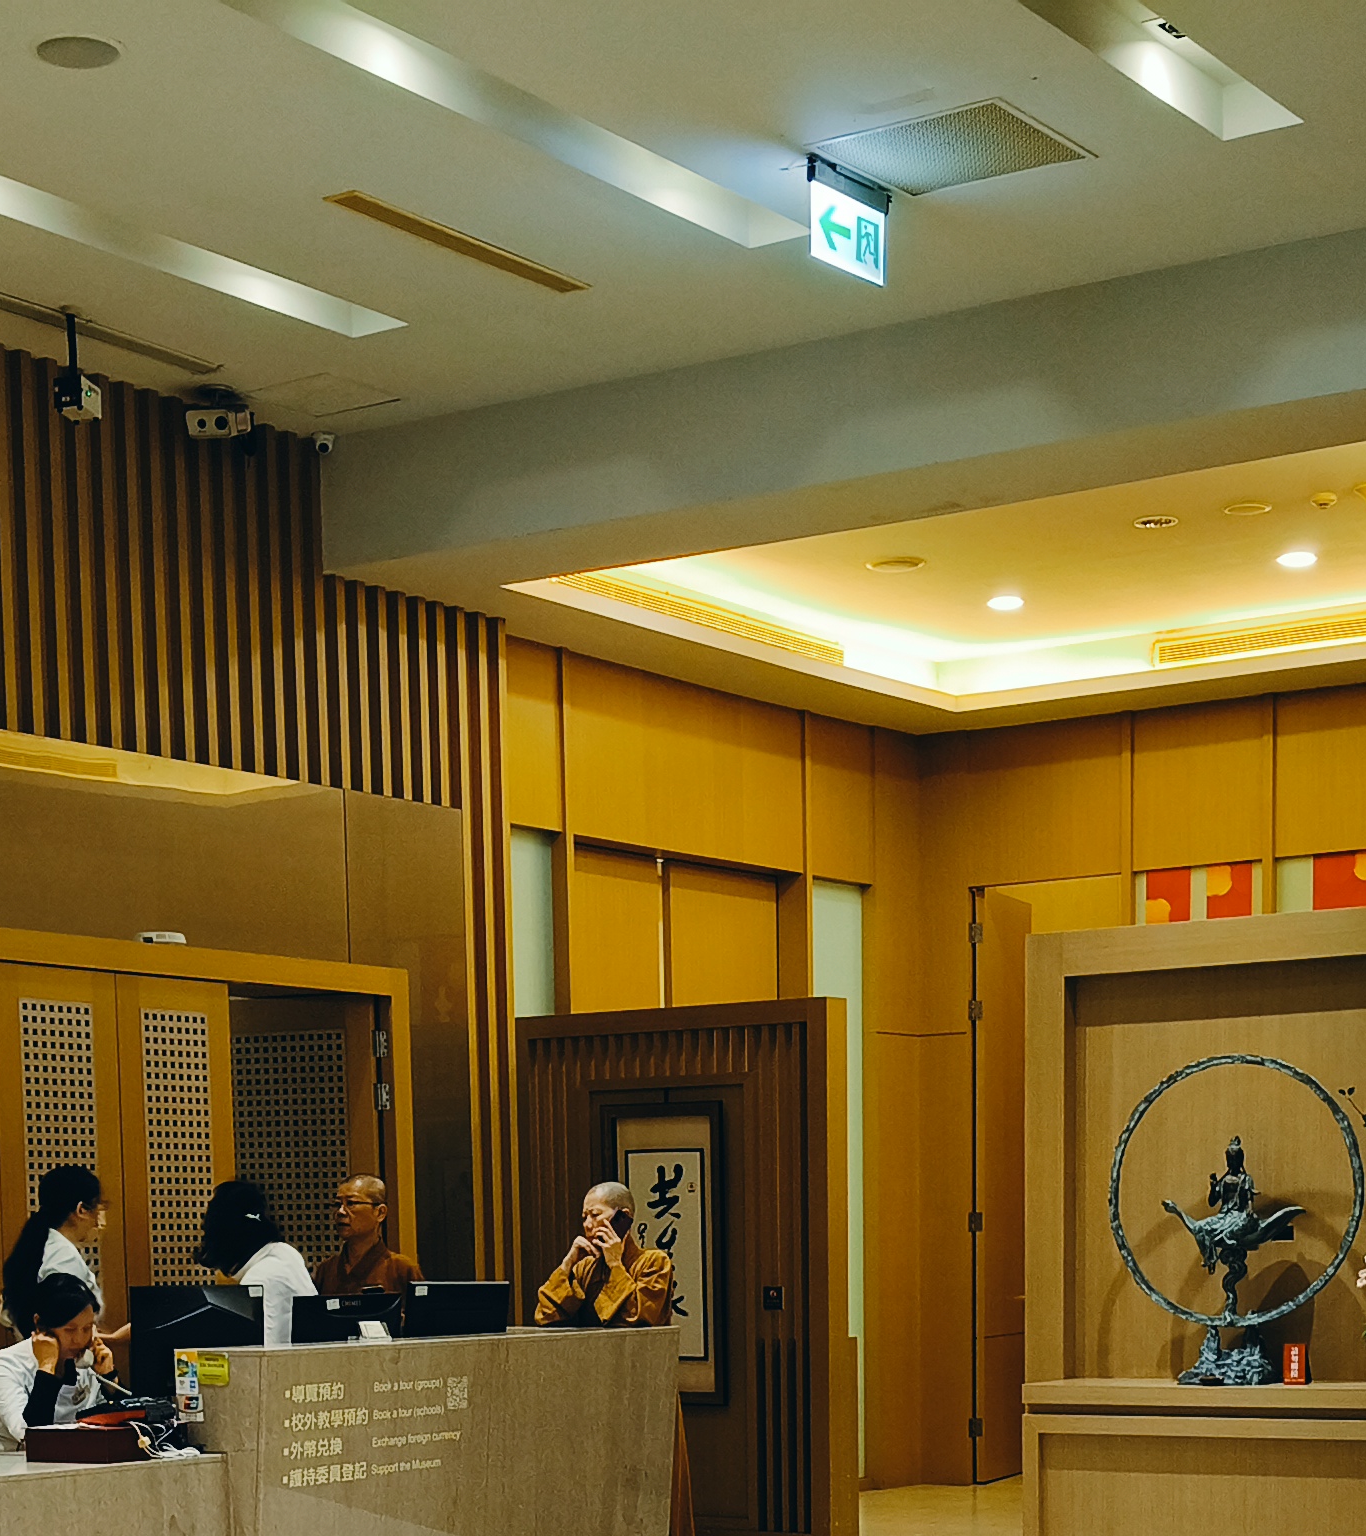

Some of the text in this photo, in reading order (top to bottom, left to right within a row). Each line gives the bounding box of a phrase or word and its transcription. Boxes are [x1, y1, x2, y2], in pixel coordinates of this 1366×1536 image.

[292, 1382, 344, 1404] 導覽預約
[415, 1377, 443, 1390] (groups)
[291, 1407, 369, 1432] 校外教學預約
[413, 1404, 444, 1418] (schools)
[290, 1431, 461, 1460] 外幣兌換 Exchange foreign currency
[289, 1458, 442, 1488] 護持委員登記 Support the Museum
